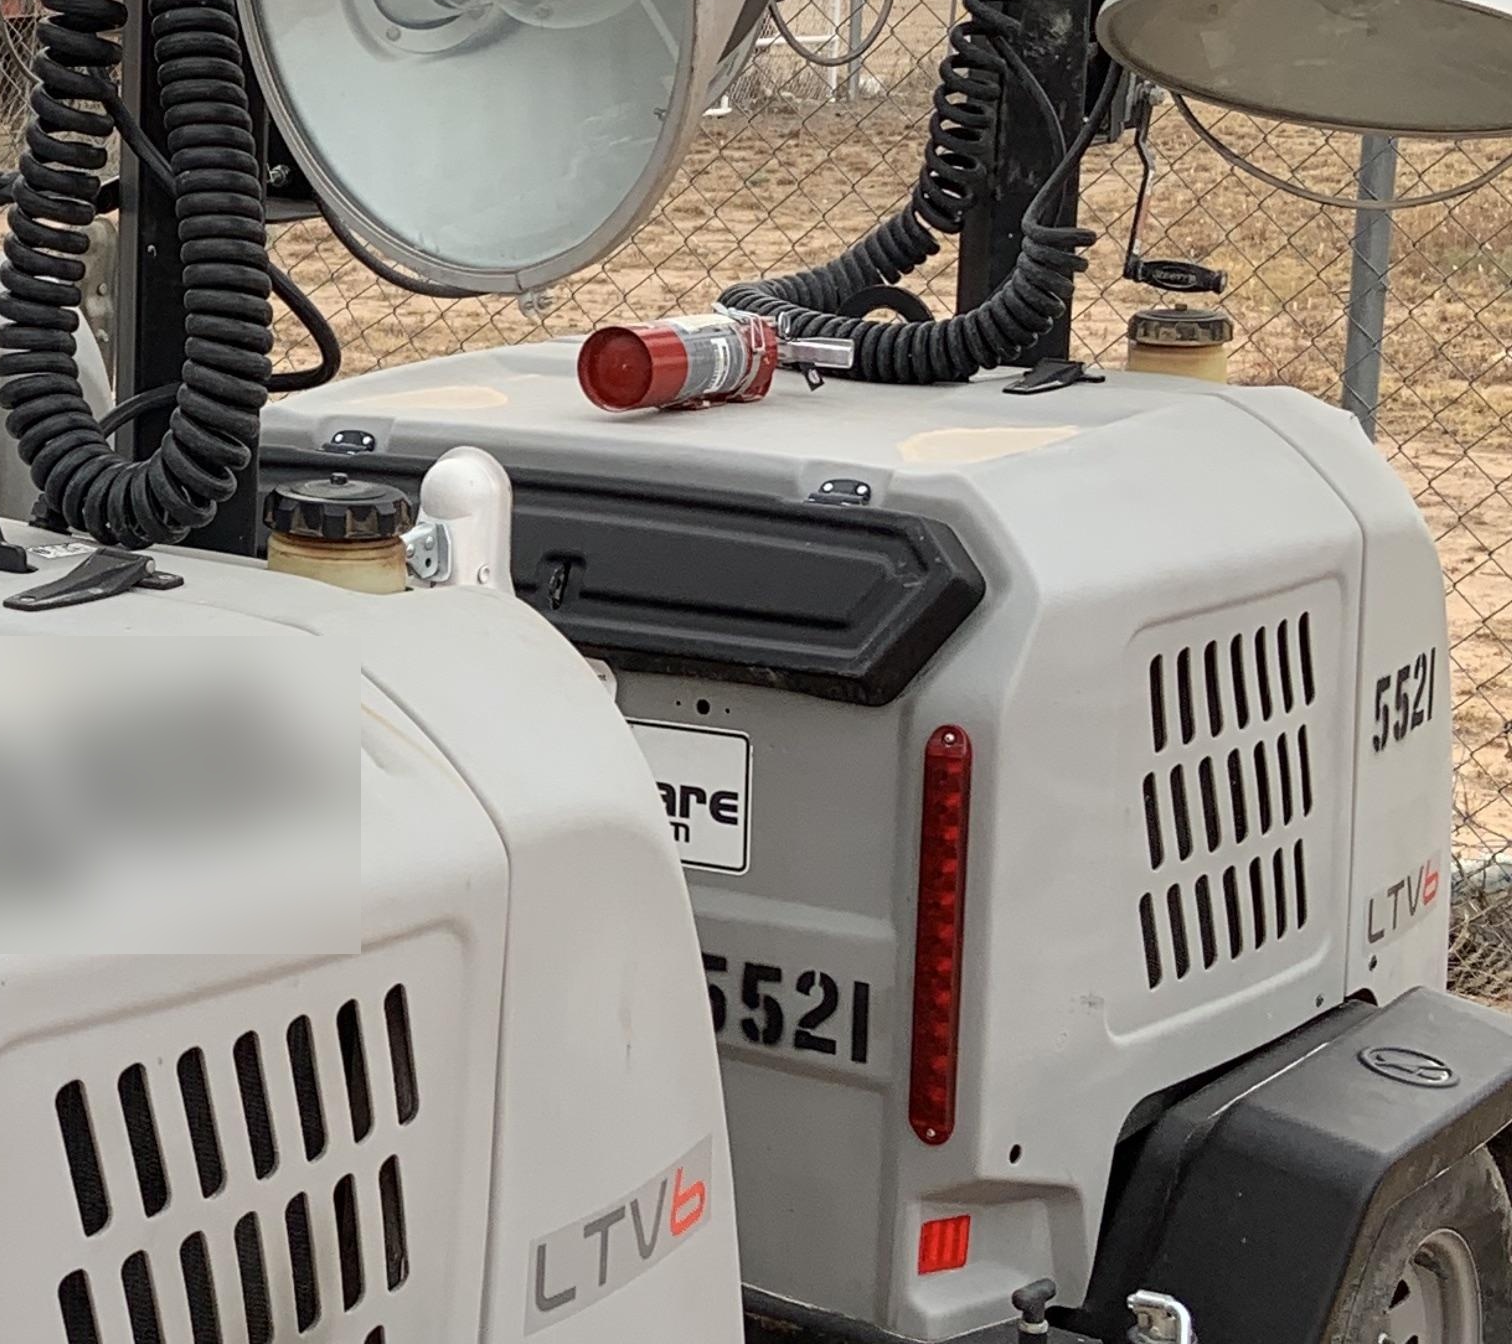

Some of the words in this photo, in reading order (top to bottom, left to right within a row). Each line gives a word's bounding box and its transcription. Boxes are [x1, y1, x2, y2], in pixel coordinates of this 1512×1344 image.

[1372, 646, 1436, 753] 5521
[1368, 859, 1439, 944] LTV6
[535, 1166, 706, 1313] LTV6
